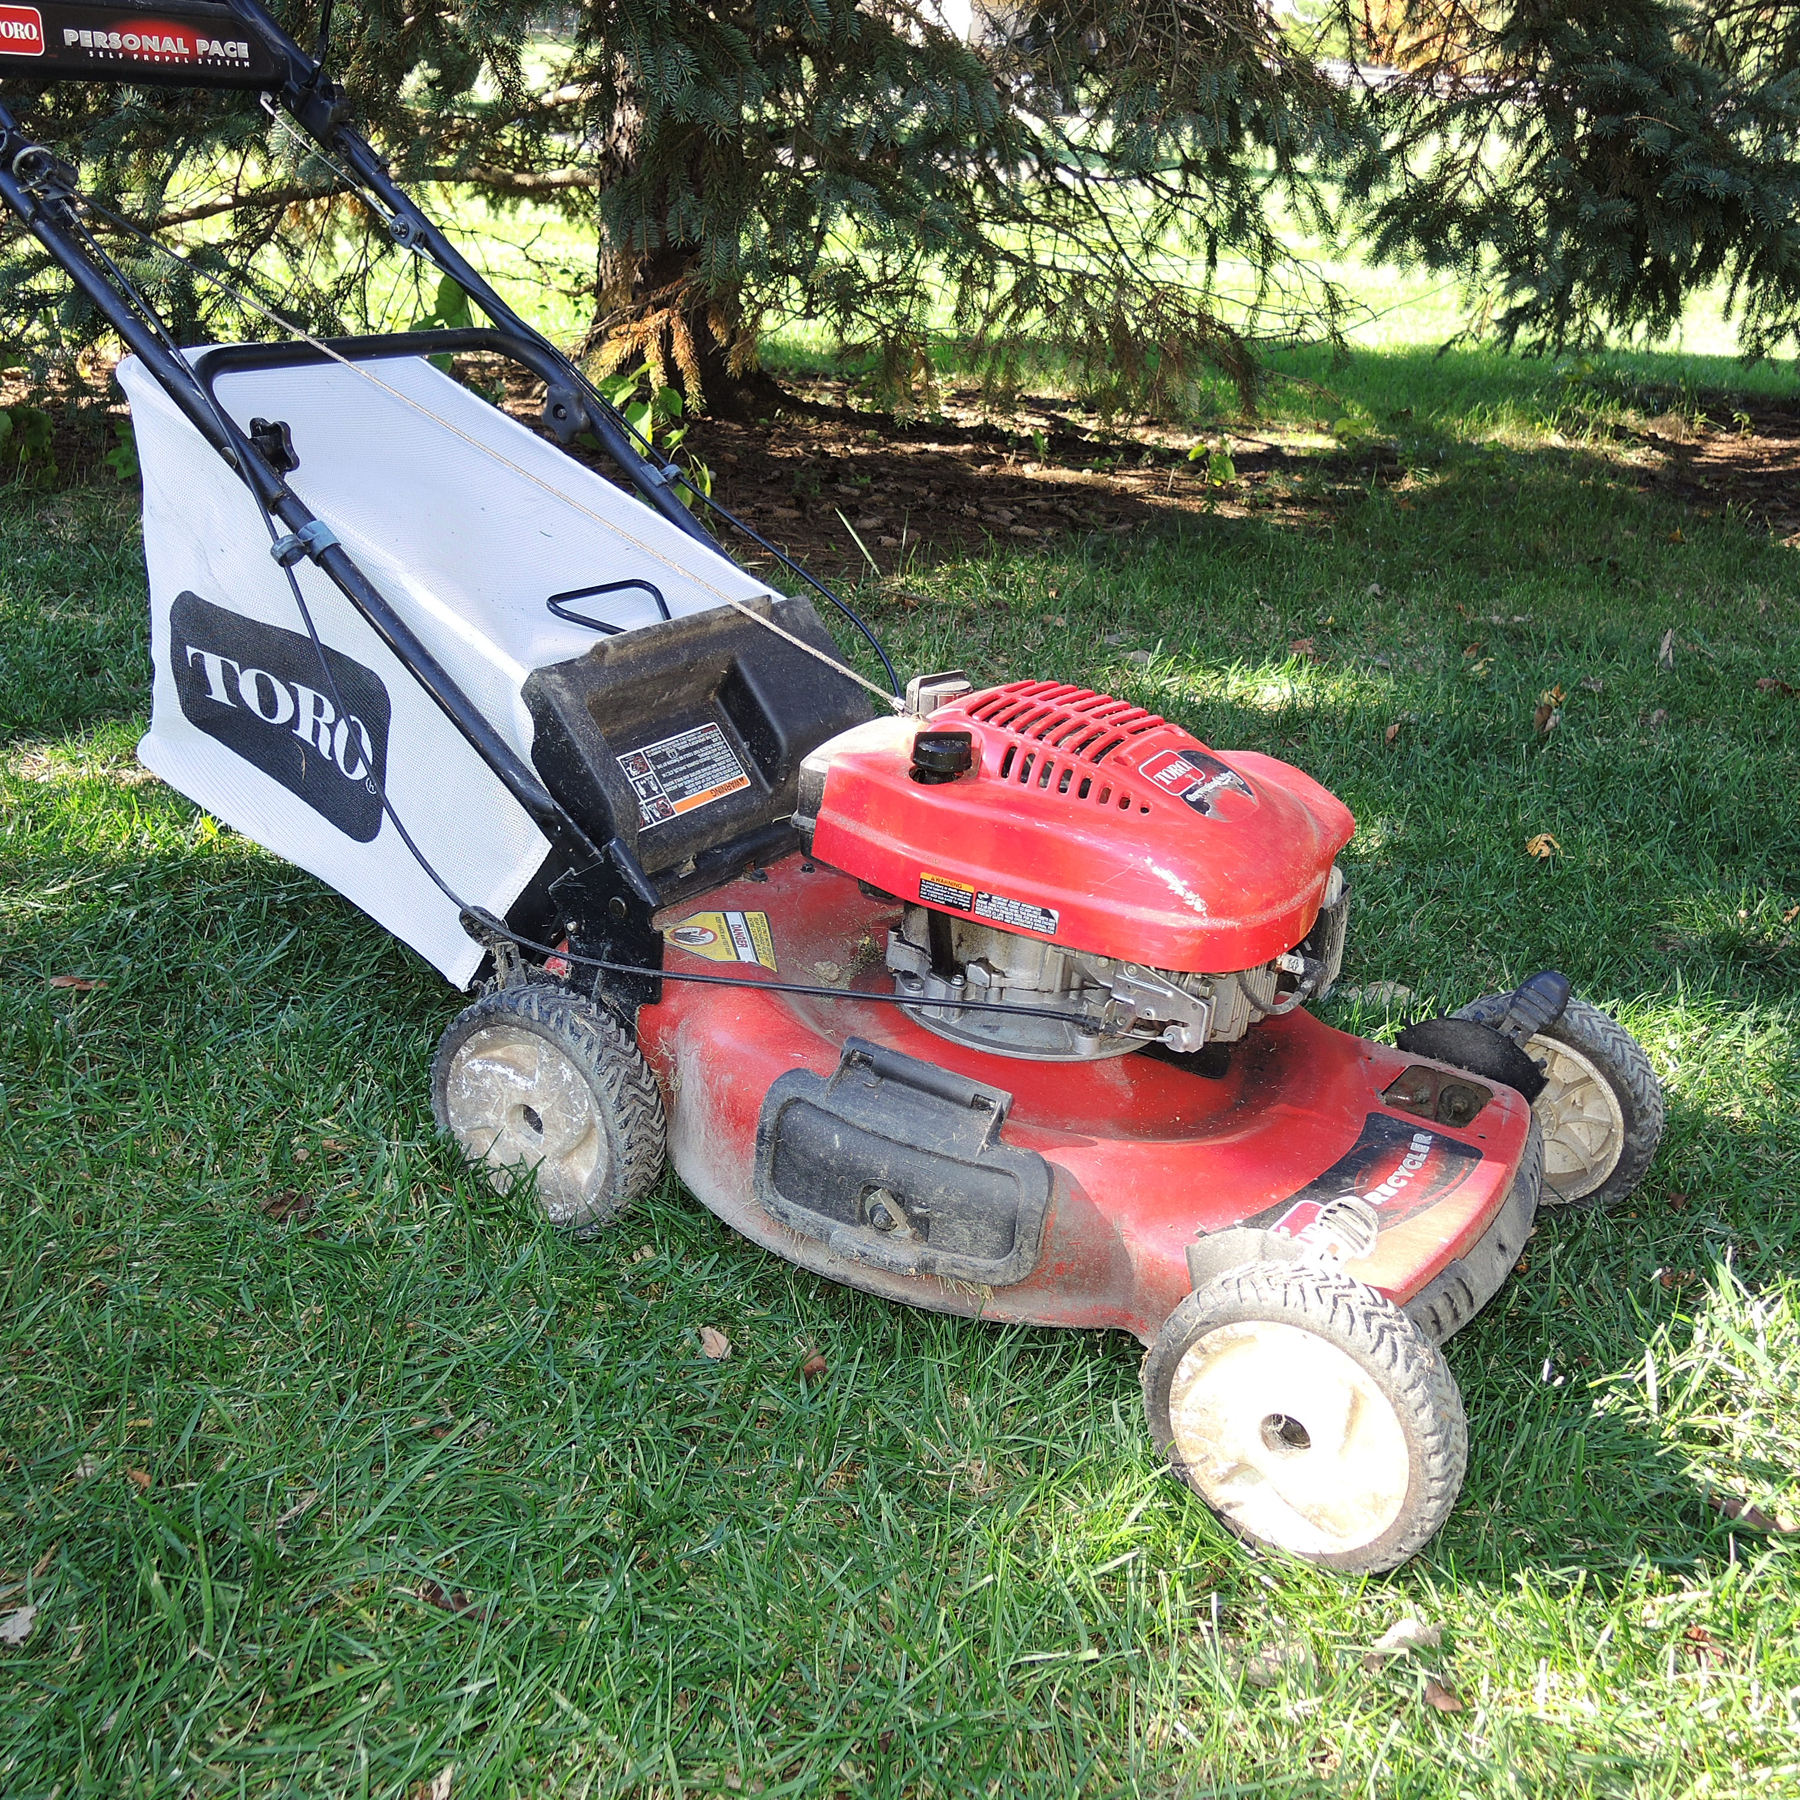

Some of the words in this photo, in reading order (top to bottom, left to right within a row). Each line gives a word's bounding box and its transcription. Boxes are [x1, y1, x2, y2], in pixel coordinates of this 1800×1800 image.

[0, 20, 38, 41] ORO
[63, 28, 189, 54] PERSONAL
[196, 39, 250, 59] PACE
[88, 50, 124, 60] SELF
[133, 53, 189, 64] PROPEL
[197, 58, 250, 68] SYSTEM
[185, 644, 374, 782] TORO
[1152, 760, 1192, 786] TORO
[709, 777, 741, 797] WARNING
[935, 876, 963, 889] WARNING
[731, 924, 749, 948] DANGER
